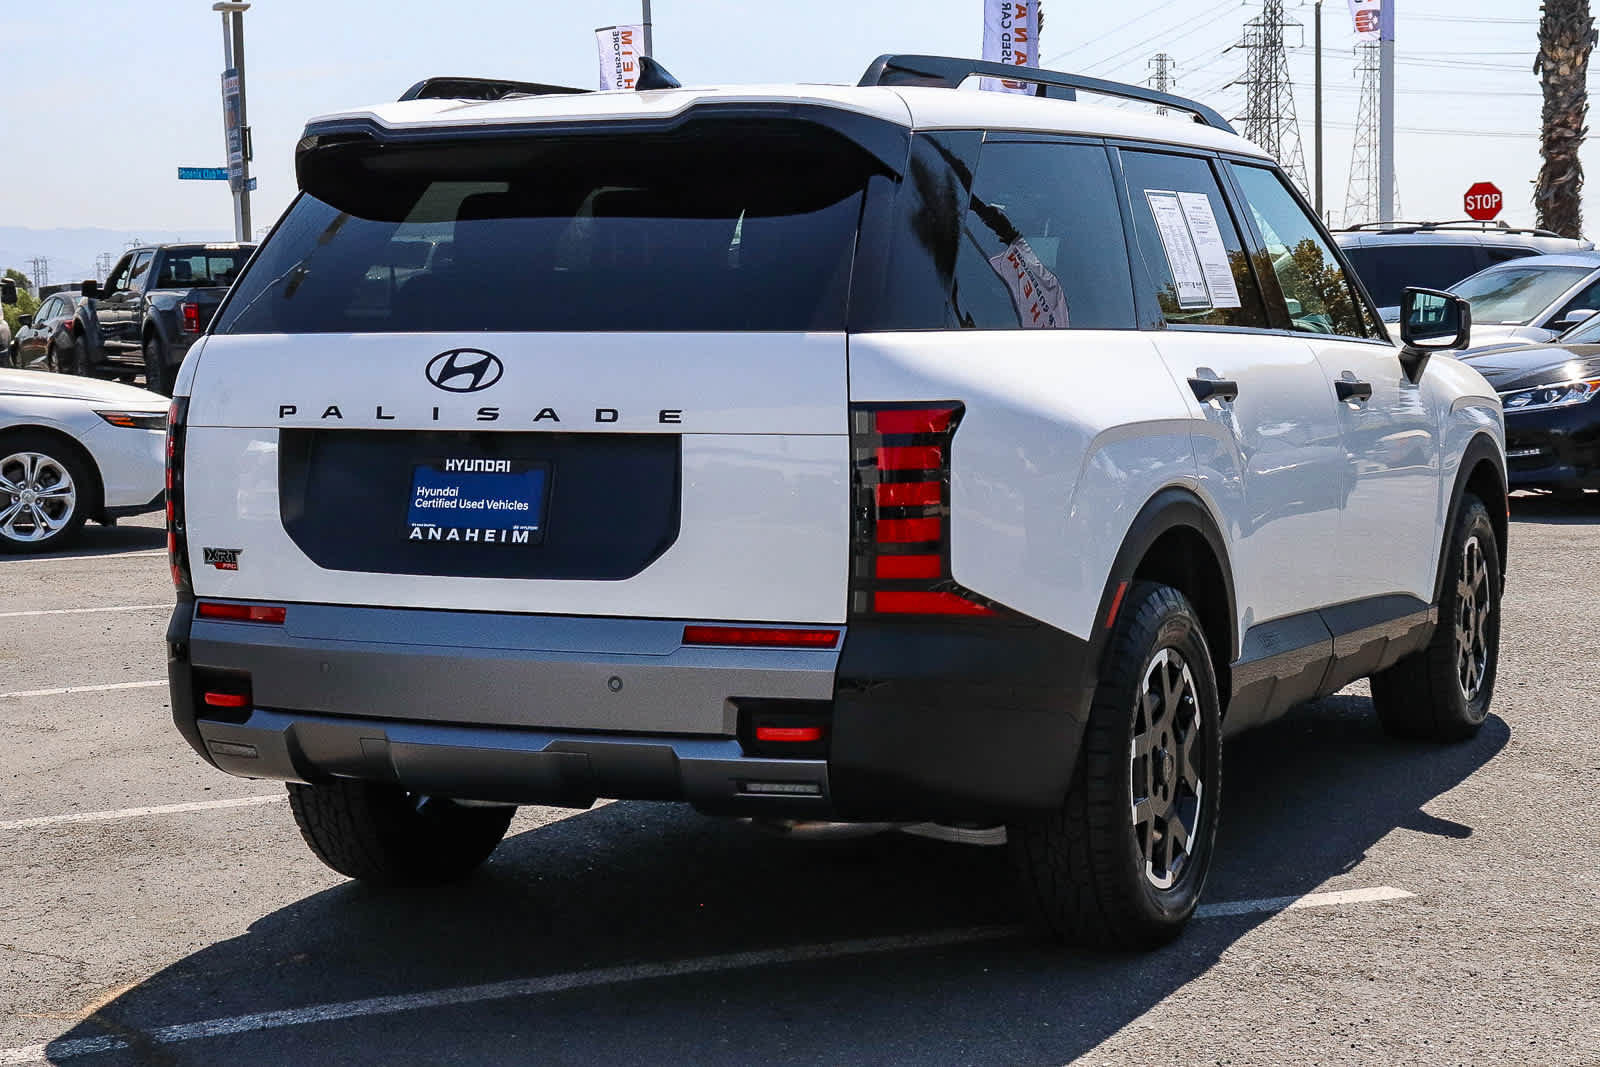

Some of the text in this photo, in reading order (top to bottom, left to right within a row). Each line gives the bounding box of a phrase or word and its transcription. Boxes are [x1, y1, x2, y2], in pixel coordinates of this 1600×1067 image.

[1466, 194, 1500, 210] STOP
[279, 405, 683, 424] PALISADE
[445, 459, 511, 472] HYUNDAI
[416, 486, 459, 498] Hyundai
[415, 498, 529, 510] Certified Used Vehicles
[409, 527, 529, 543] ANAHEIM
[203, 547, 243, 563] XRT
